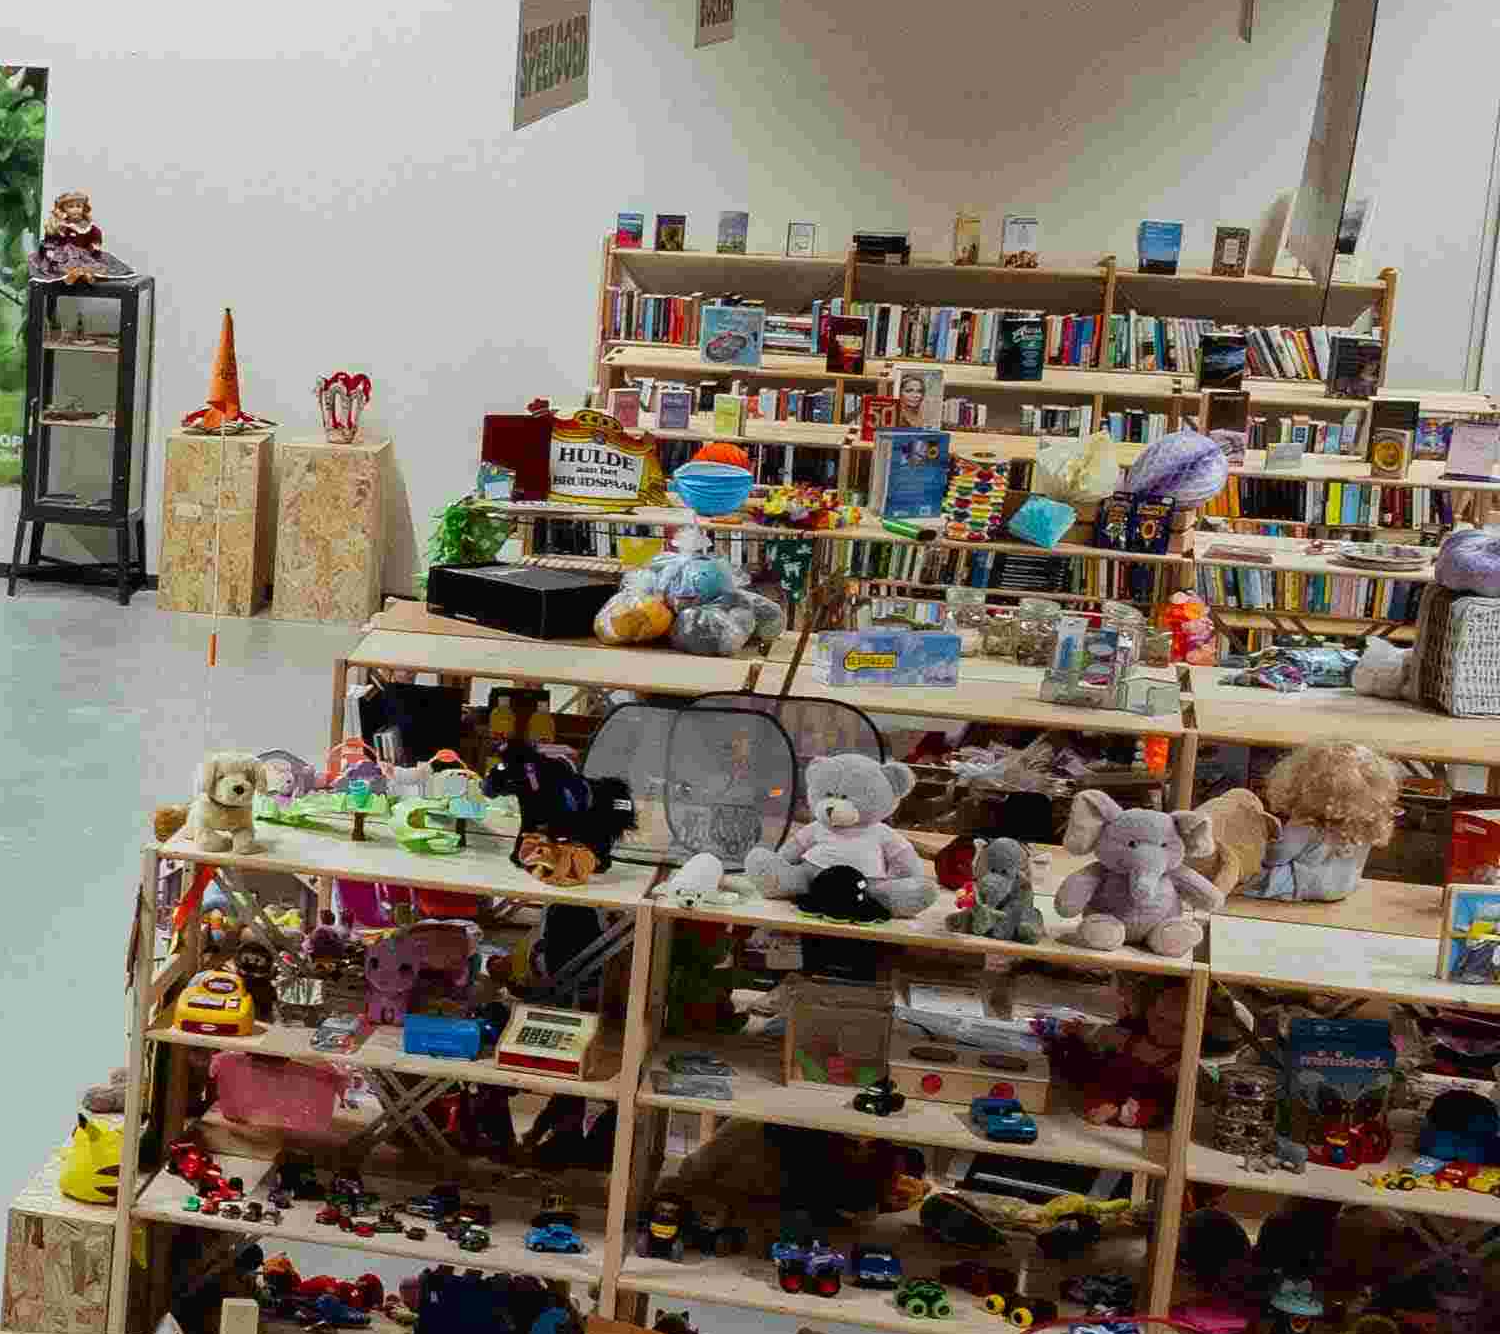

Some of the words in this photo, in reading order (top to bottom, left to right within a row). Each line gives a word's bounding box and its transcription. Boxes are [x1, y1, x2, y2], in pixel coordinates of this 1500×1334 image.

[558, 446, 638, 472] HULDE
[599, 466, 618, 476] het
[551, 475, 638, 494] BRUIDSPAAR
